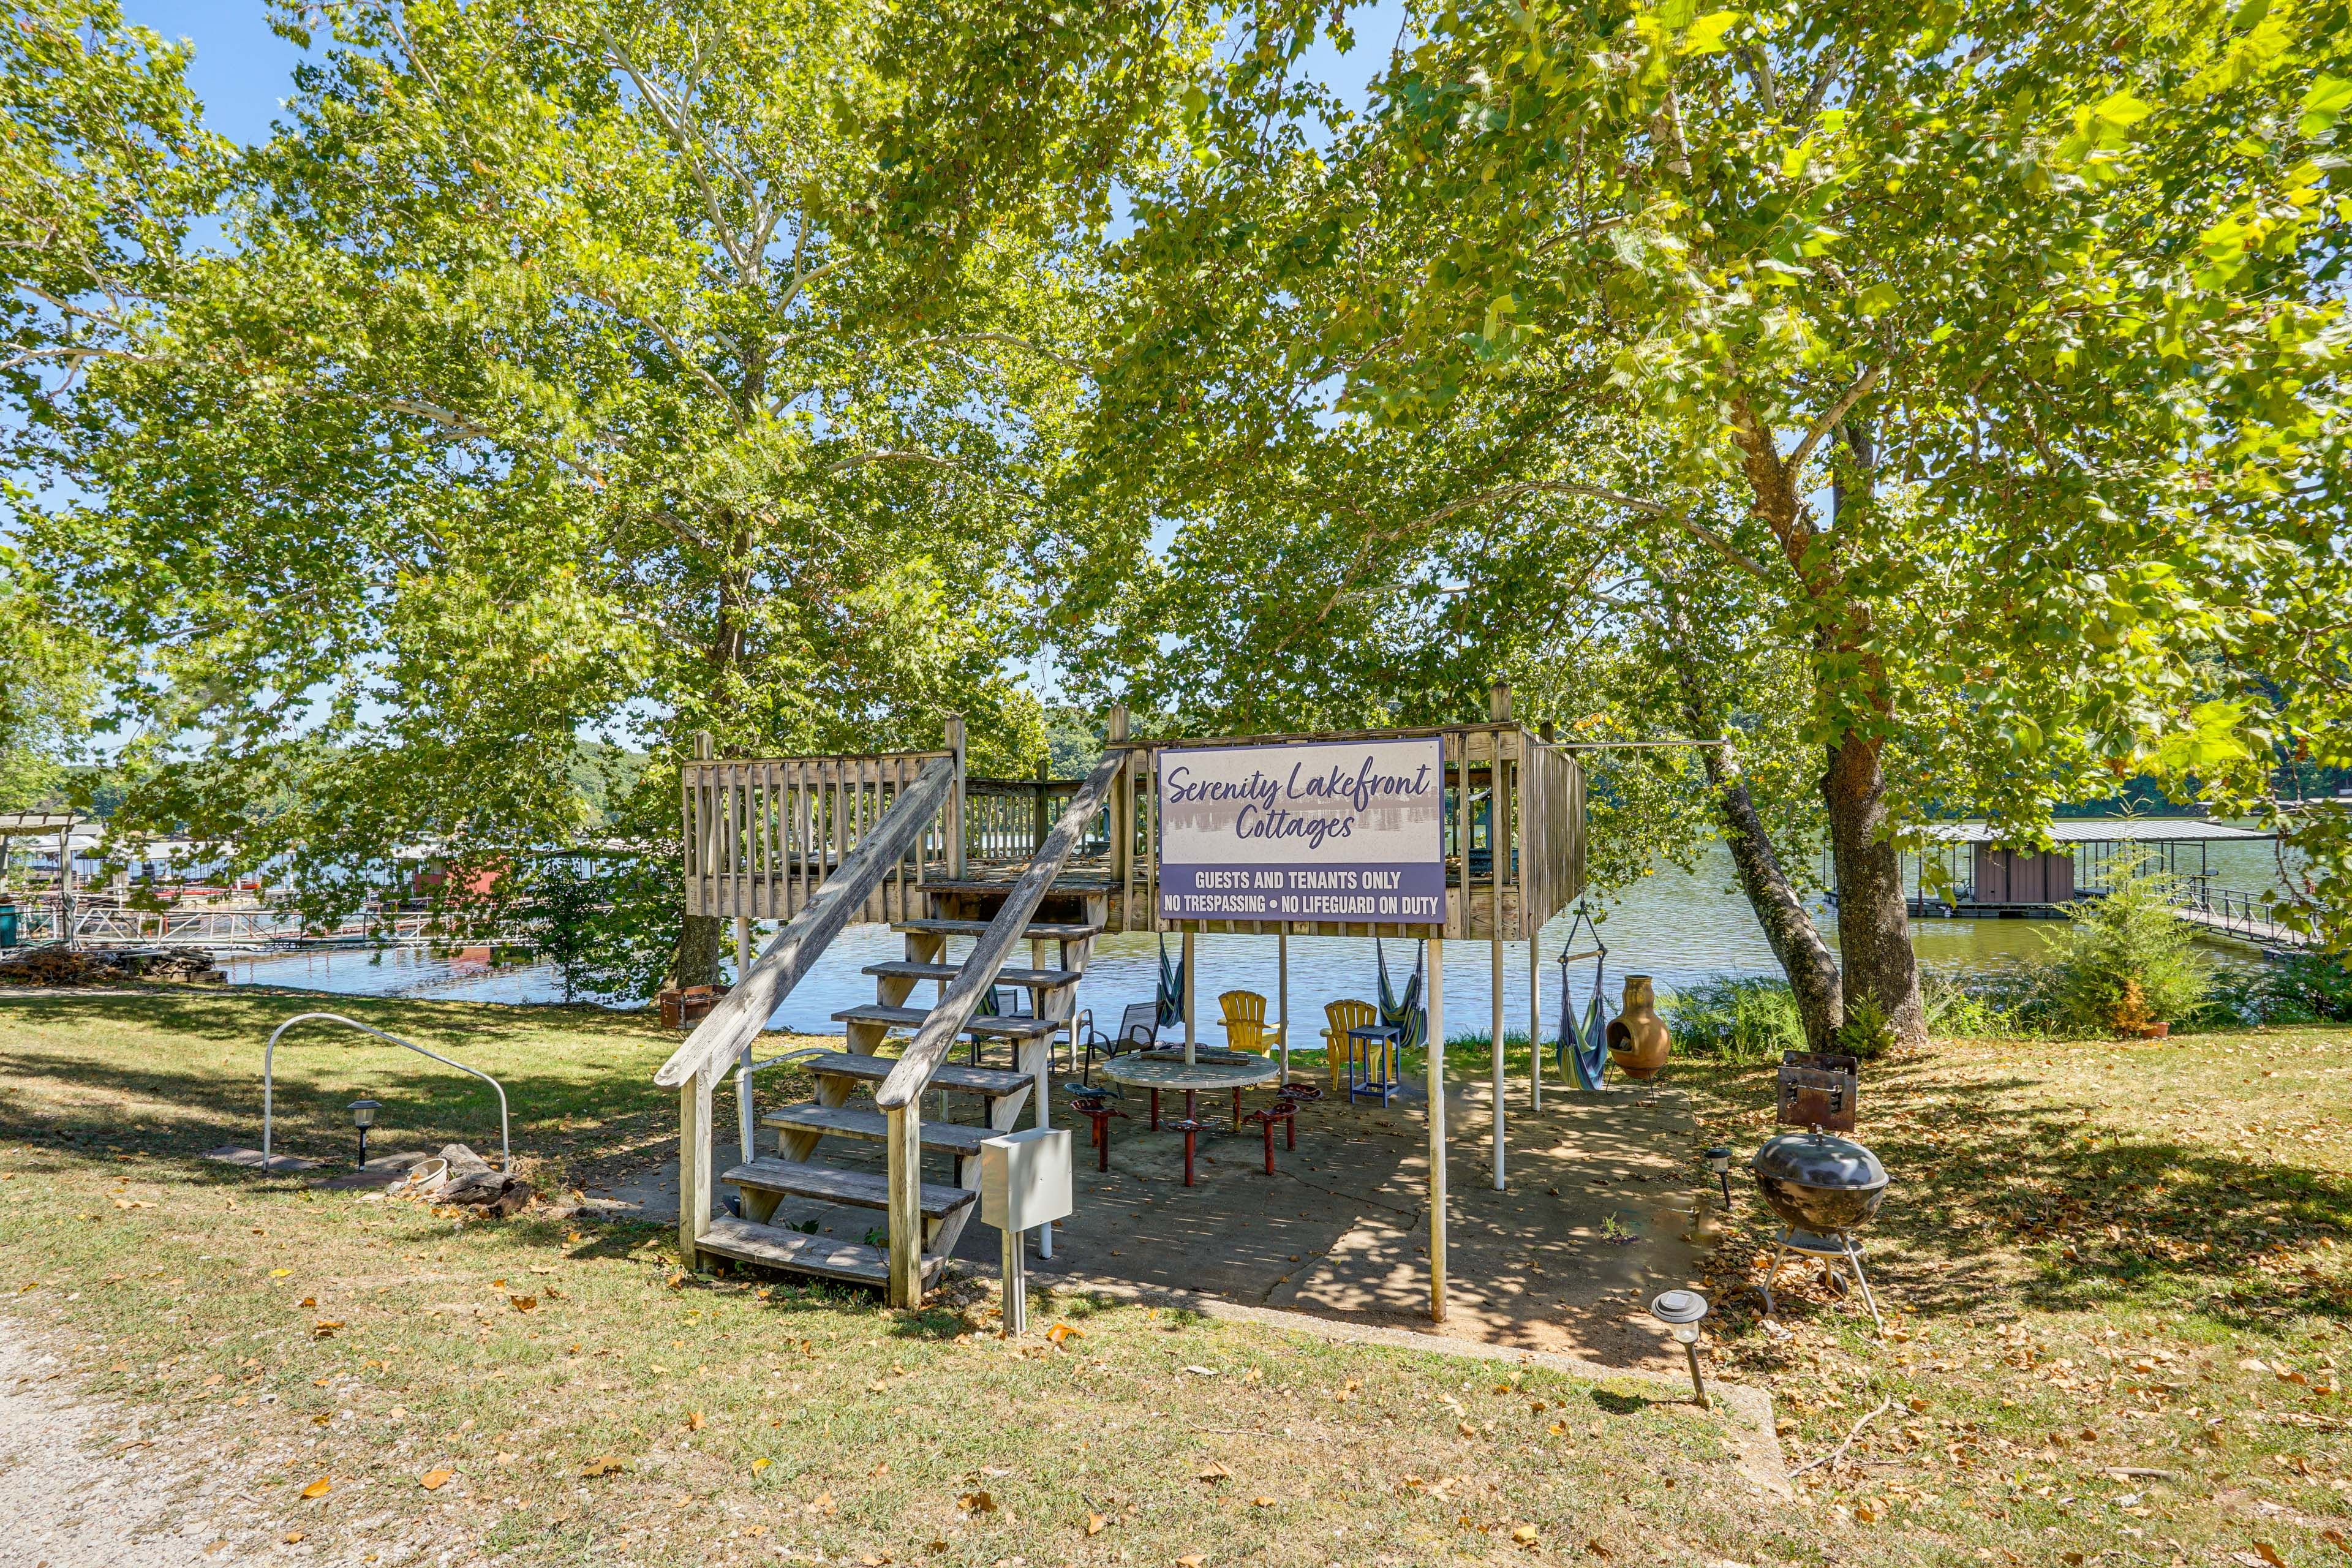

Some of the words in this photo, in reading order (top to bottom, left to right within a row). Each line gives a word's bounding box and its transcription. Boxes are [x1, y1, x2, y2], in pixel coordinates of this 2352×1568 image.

[1167, 766, 1283, 810] Serenity
[1287, 755, 1431, 812] Lakefront
[1235, 804, 1355, 850] Cottages
[1195, 871, 1250, 889] GUESTS
[1254, 872, 1284, 889] AND
[1288, 871, 1358, 889] TENANTS
[1362, 871, 1401, 889] ONLY
[1164, 894, 1181, 911] NO
[1184, 894, 1265, 913] TRESPASSING
[1281, 895, 1299, 913] NO
[1302, 895, 1375, 914] LIFEGUARD
[1379, 896, 1398, 914] ON
[1402, 896, 1439, 914] DUTY
